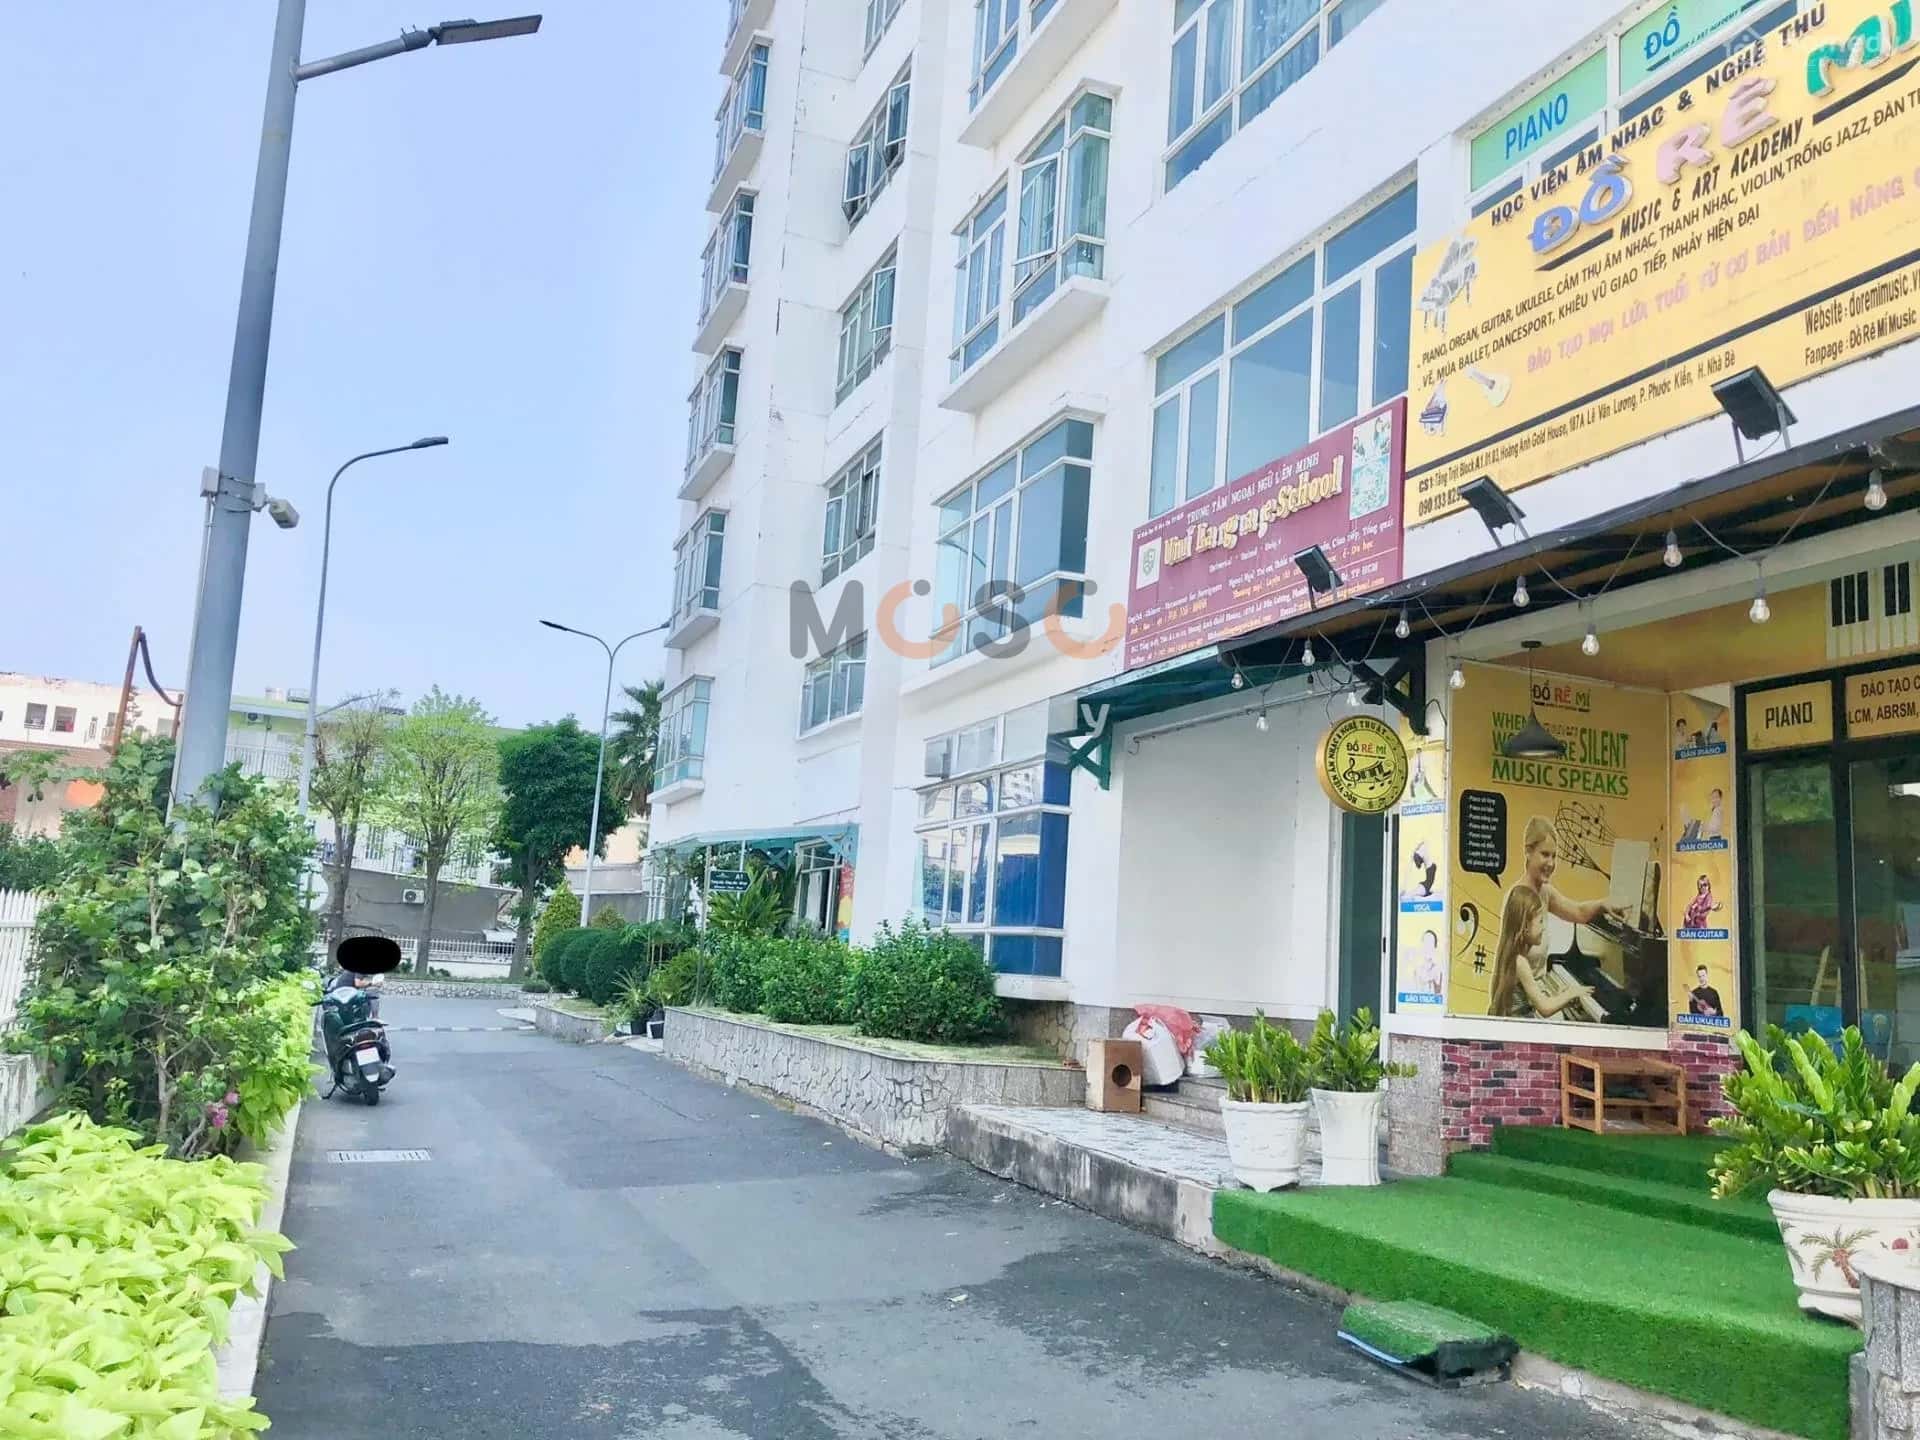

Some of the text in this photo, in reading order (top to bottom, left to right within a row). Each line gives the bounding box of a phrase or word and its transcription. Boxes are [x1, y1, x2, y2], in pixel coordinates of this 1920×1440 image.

[1491, 194, 1524, 226] HỌC
[1530, 167, 1569, 202] VIỆN
[1576, 141, 1603, 176] ÂM
[1611, 109, 1664, 157] NHẠC
[1677, 89, 1693, 111] &
[1706, 38, 1766, 94] NGHỆ
[1505, 92, 1569, 161] PIANO
[1526, 153, 1634, 255] ĐỒ
[1656, 76, 1780, 185] RÊ
[1619, 198, 1663, 242] MUSIC
[1692, 164, 1721, 201] ART
[1731, 116, 1804, 179] ACADEMY
[1422, 341, 1448, 366] PIANO,
[1450, 325, 1480, 352] ORGAN,
[1481, 307, 1514, 336] GUITAR,
[1515, 285, 1556, 319] UKULELE,
[1556, 269, 1580, 296] CẢM
[1581, 264, 1602, 291] THỤ
[1604, 247, 1622, 272] ÂM
[1625, 231, 1658, 259] NHẠC,
[1659, 210, 1700, 239] THANH
[1703, 188, 1739, 219] NHẠC,
[1741, 165, 1786, 197] VIOLIN,
[1786, 136, 1833, 174] TRỐNG
[1836, 118, 1872, 148] JAZZ,
[1873, 95, 1906, 127] ĐÀN
[1756, 229, 1792, 266] BẢN
[1802, 202, 1841, 243] ĐẾN
[1437, 360, 1457, 381] MÚA
[1458, 343, 1491, 371] BALLET,
[1492, 311, 1556, 353] DANCESPORT,
[1558, 291, 1589, 319] KHIÊU
[1591, 279, 1607, 302] VŨ
[1610, 267, 1638, 294] GIAO
[1671, 231, 1702, 262] NHẢY
[1706, 216, 1734, 244] HIỆN
[1738, 203, 1760, 229] ĐẠI
[1805, 297, 1843, 336] Website
[1805, 342, 1844, 368] Fanpage
[1888, 308, 1918, 334] Music
[1532, 431, 1546, 448] Gold
[1707, 355, 1722, 376] Nhà
[1724, 349, 1736, 369] Bè
[1277, 454, 1345, 519] School
[1295, 451, 1321, 476] MINH
[1765, 701, 1814, 730] PIANO
[1848, 701, 1919, 726] LCM, ABRSM,
[1861, 679, 1885, 699] ĐÀO
[1888, 675, 1911, 697] TẠO
[1492, 758, 1629, 796] MUSIC SPEAKS
[1579, 727, 1629, 769] SILENT
[1695, 1015, 1730, 1028] UKULELE
